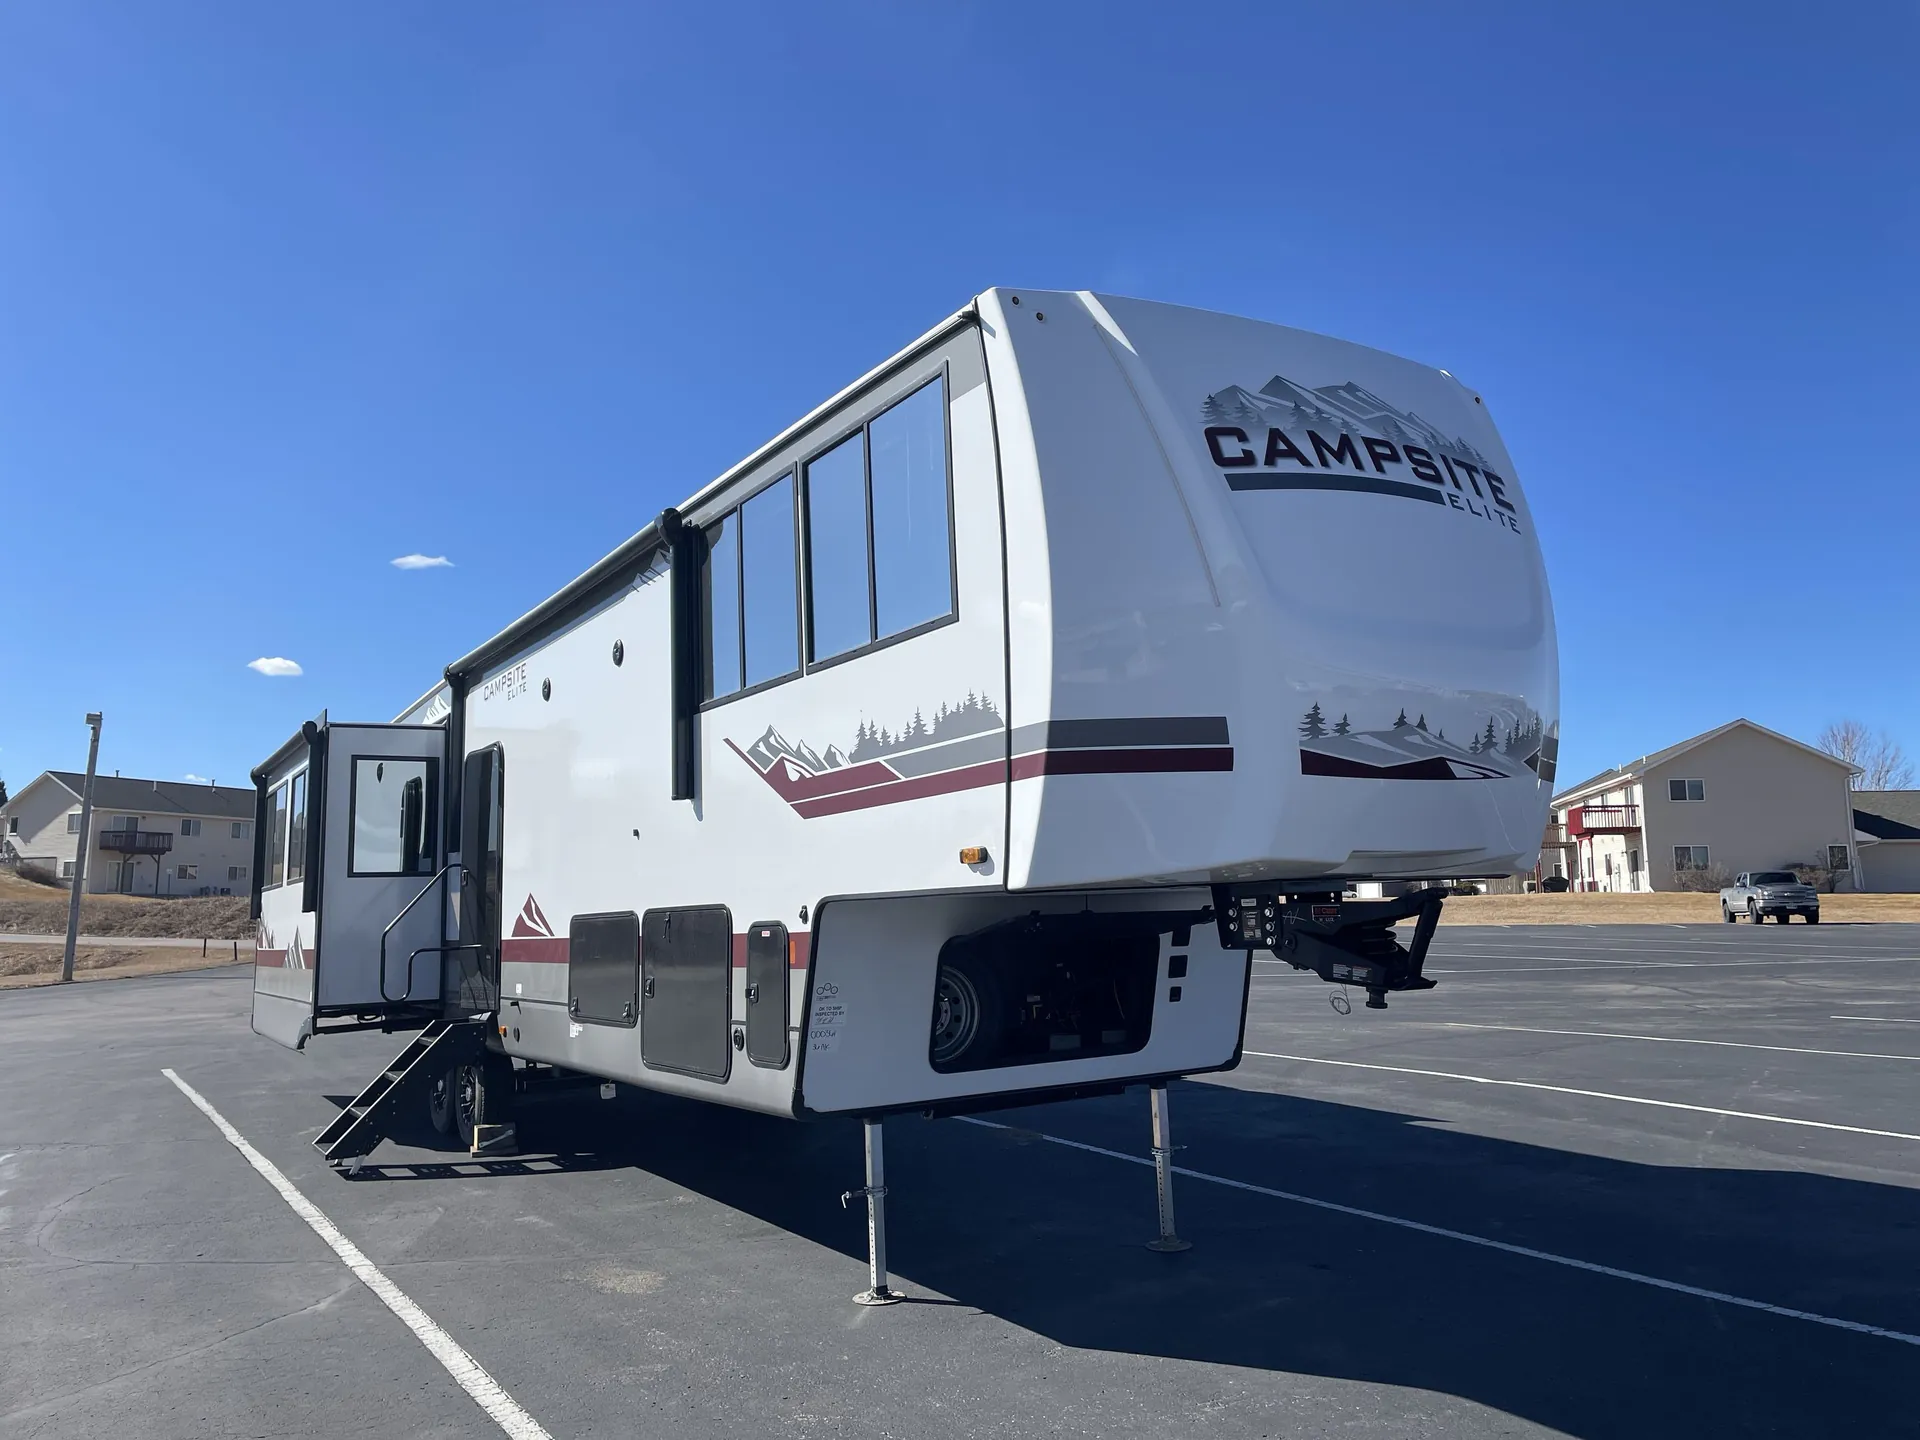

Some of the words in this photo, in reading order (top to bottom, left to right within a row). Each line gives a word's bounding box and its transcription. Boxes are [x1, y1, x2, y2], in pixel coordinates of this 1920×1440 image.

[1204, 426, 1516, 514] CAMPSITE
[1447, 492, 1521, 535] ELITE
[484, 663, 527, 701] CAMPSITE
[507, 681, 527, 701] ELITE
